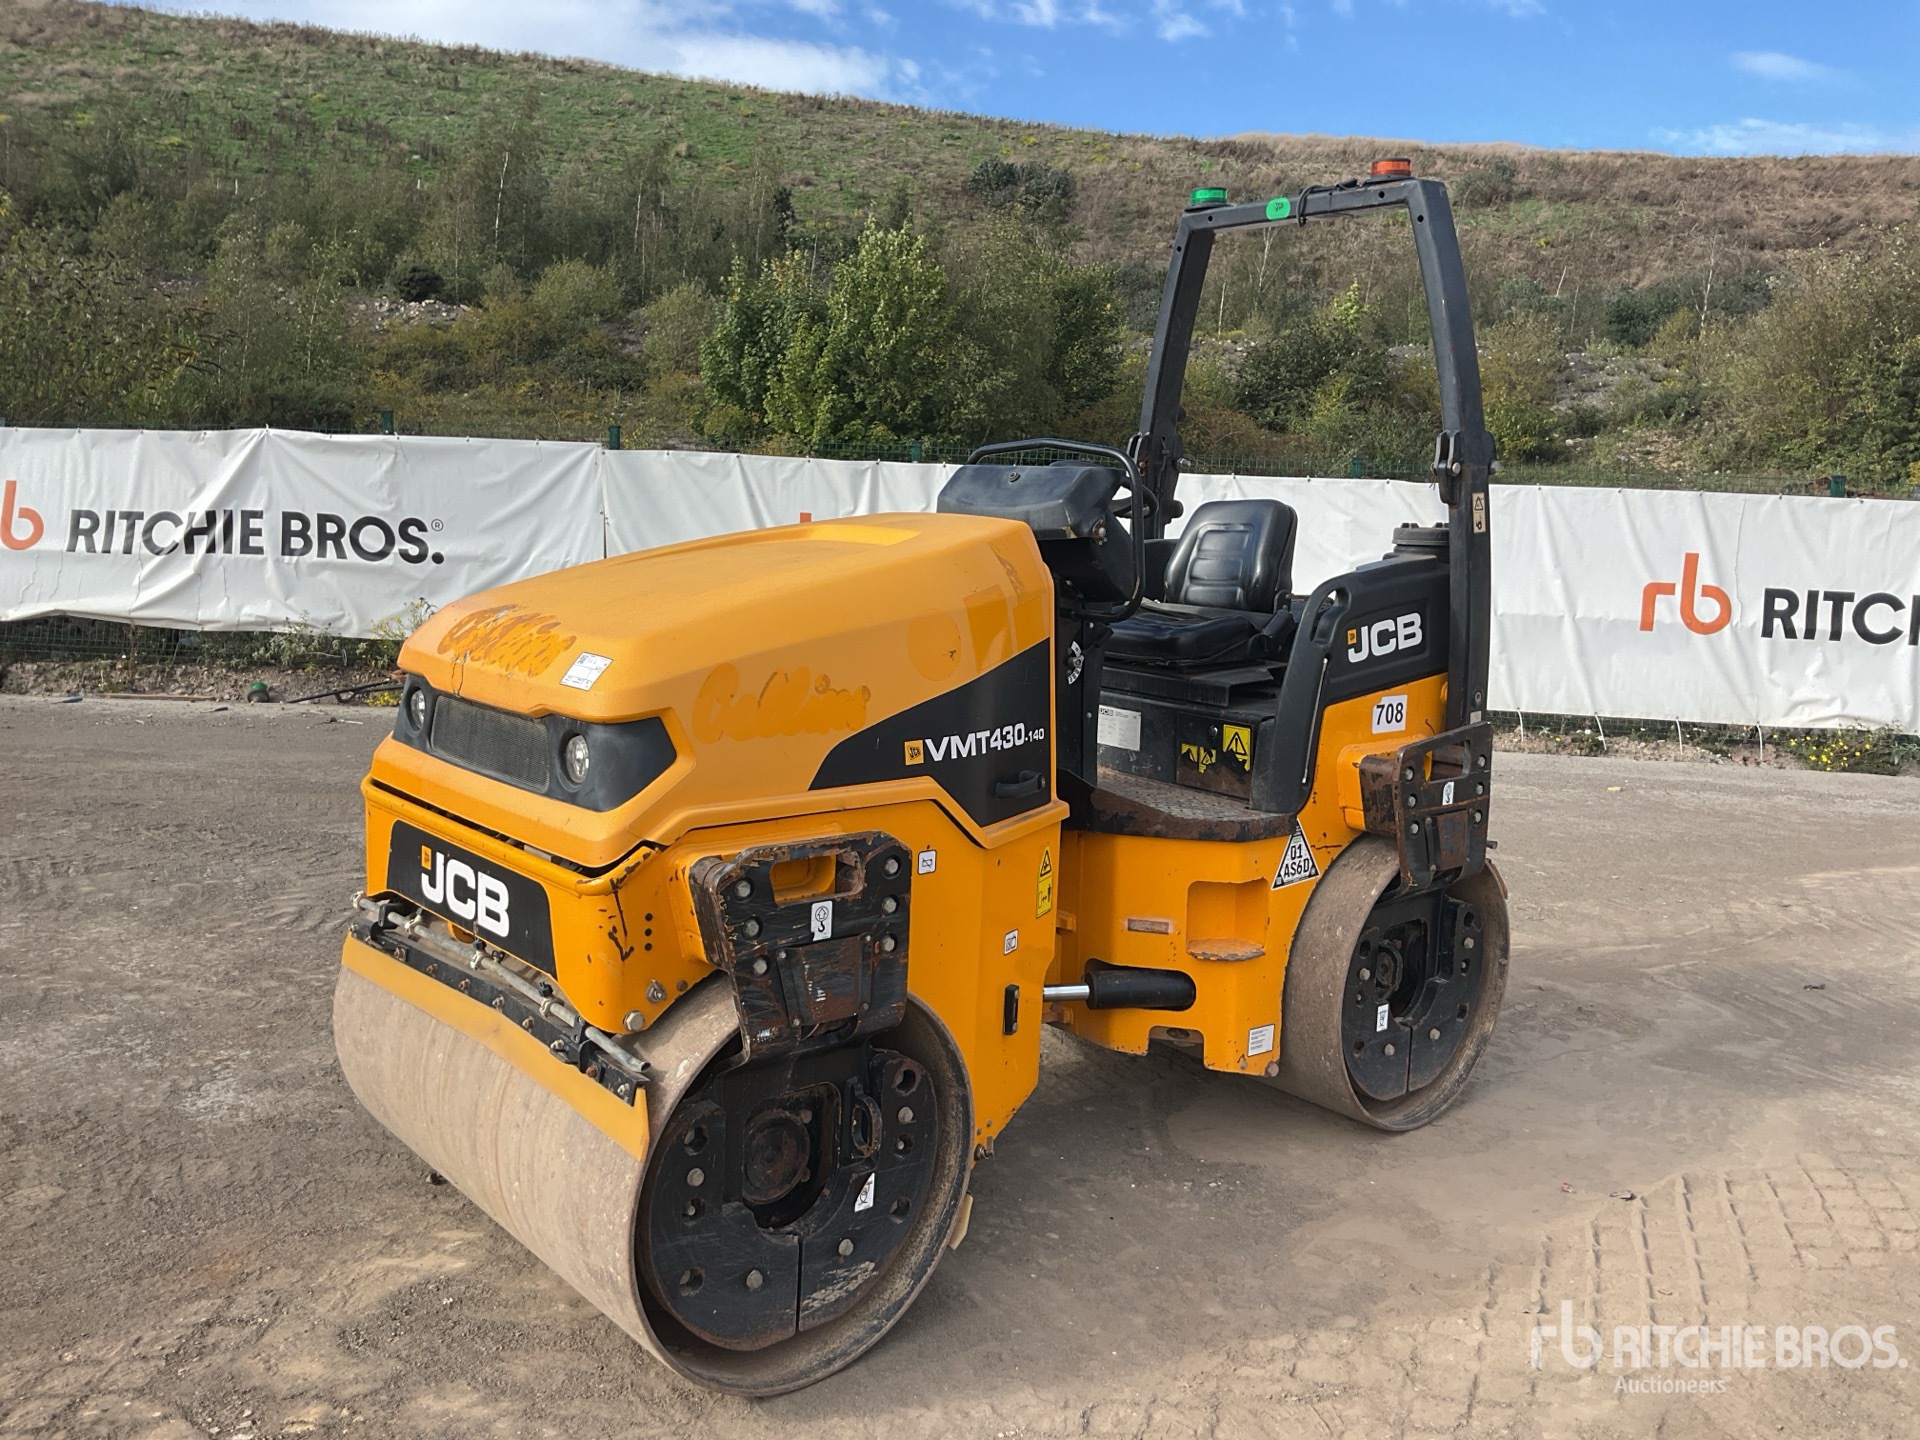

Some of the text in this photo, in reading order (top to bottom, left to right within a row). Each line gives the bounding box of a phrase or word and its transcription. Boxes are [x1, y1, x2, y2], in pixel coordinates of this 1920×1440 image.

[66, 509, 264, 556] RITCHIE
[1639, 552, 1733, 635] rb
[1348, 612, 1422, 663] JCB
[1376, 702, 1404, 726] 708
[1283, 858, 1310, 878] AS6D
[421, 851, 509, 938] JCB
